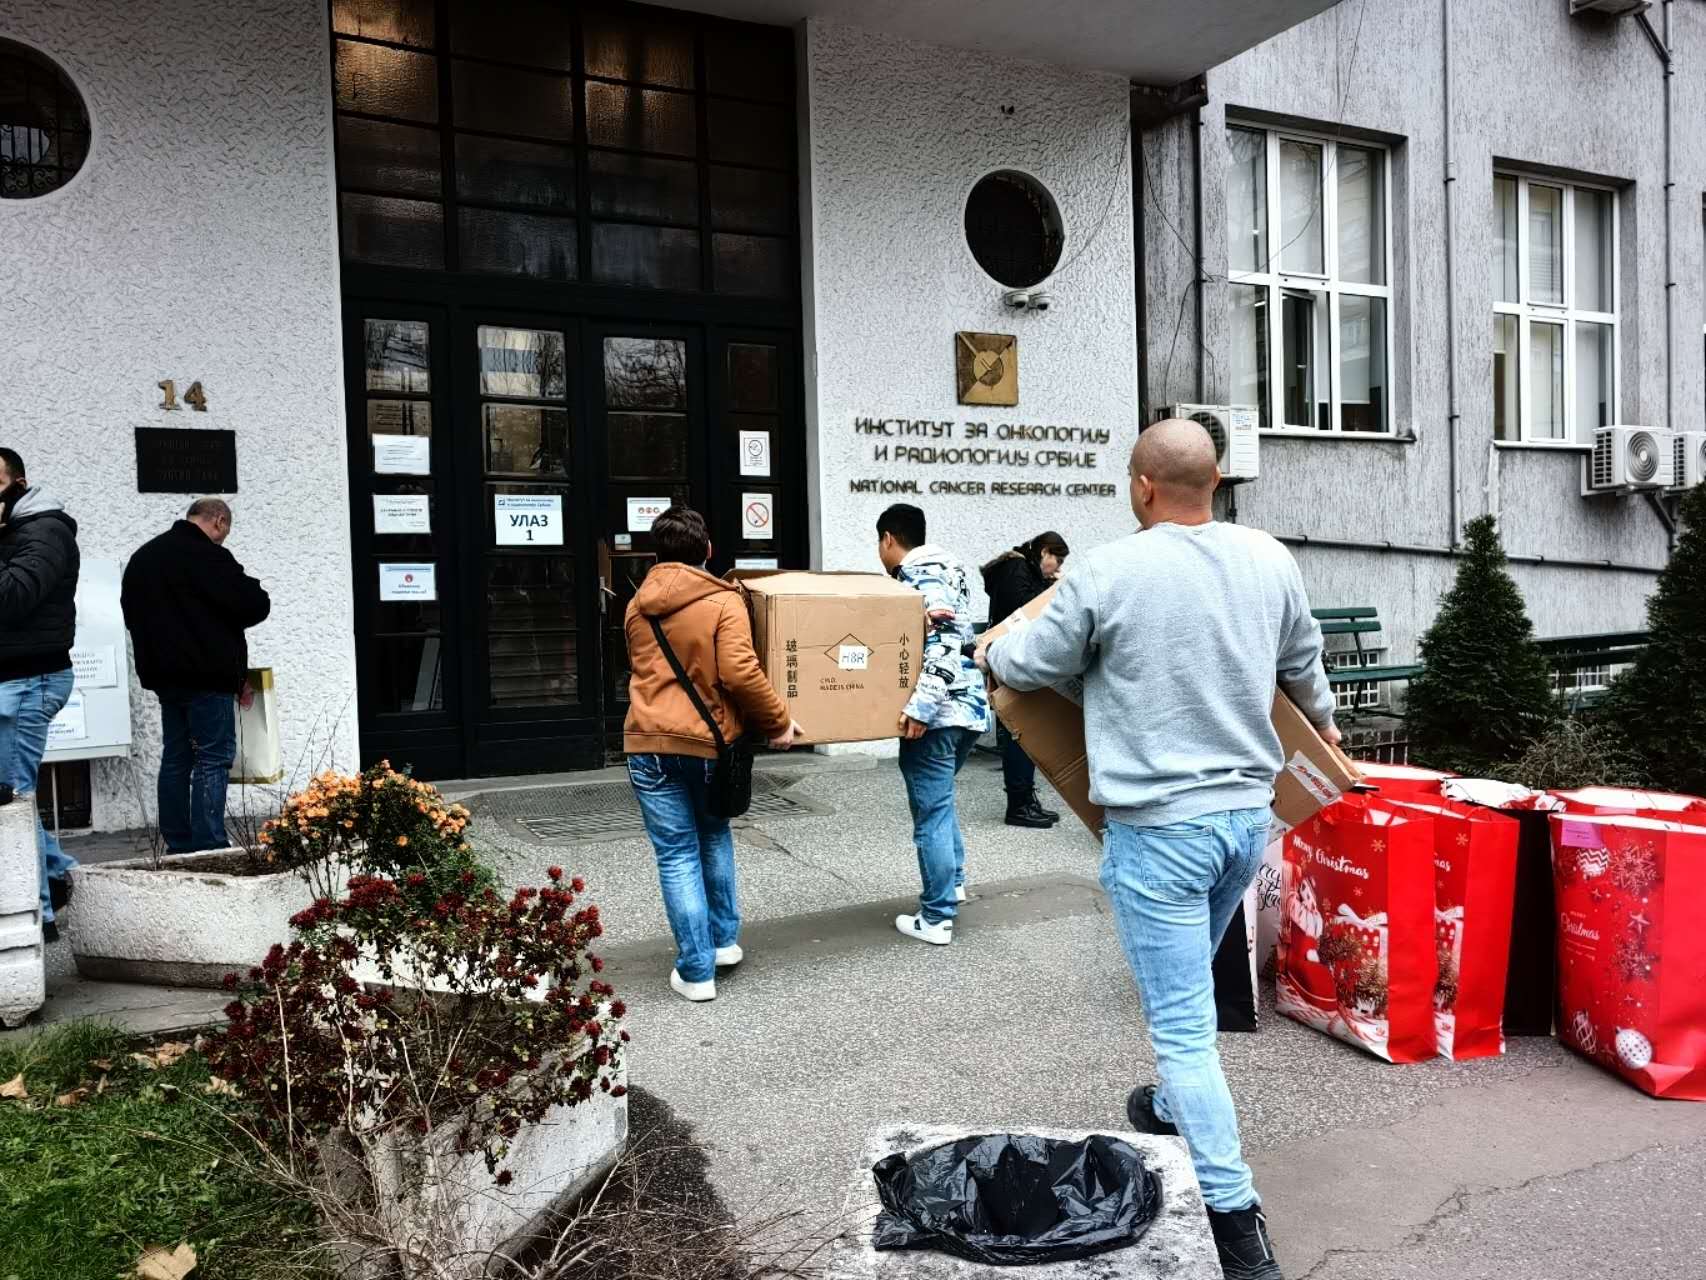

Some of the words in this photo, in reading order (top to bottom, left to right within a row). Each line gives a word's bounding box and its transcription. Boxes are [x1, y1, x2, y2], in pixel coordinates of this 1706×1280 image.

[158, 379, 208, 412] 14
[855, 417, 955, 438] ИНСТИТУТ
[964, 421, 988, 439] ЗА
[874, 445, 888, 461] И
[1035, 450, 1097, 468] СРБИЈЕ
[850, 479, 923, 495] NATIONAL
[929, 480, 986, 496] CANCER
[991, 481, 1062, 497] RESEARCH
[1066, 483, 1117, 498] CENTER
[509, 514, 549, 527] УЛАЗ
[526, 529, 534, 541] 1
[785, 638, 798, 698] 玻璃制品
[899, 632, 910, 689] 小心轻放
[1315, 848, 1370, 880] Christmas
